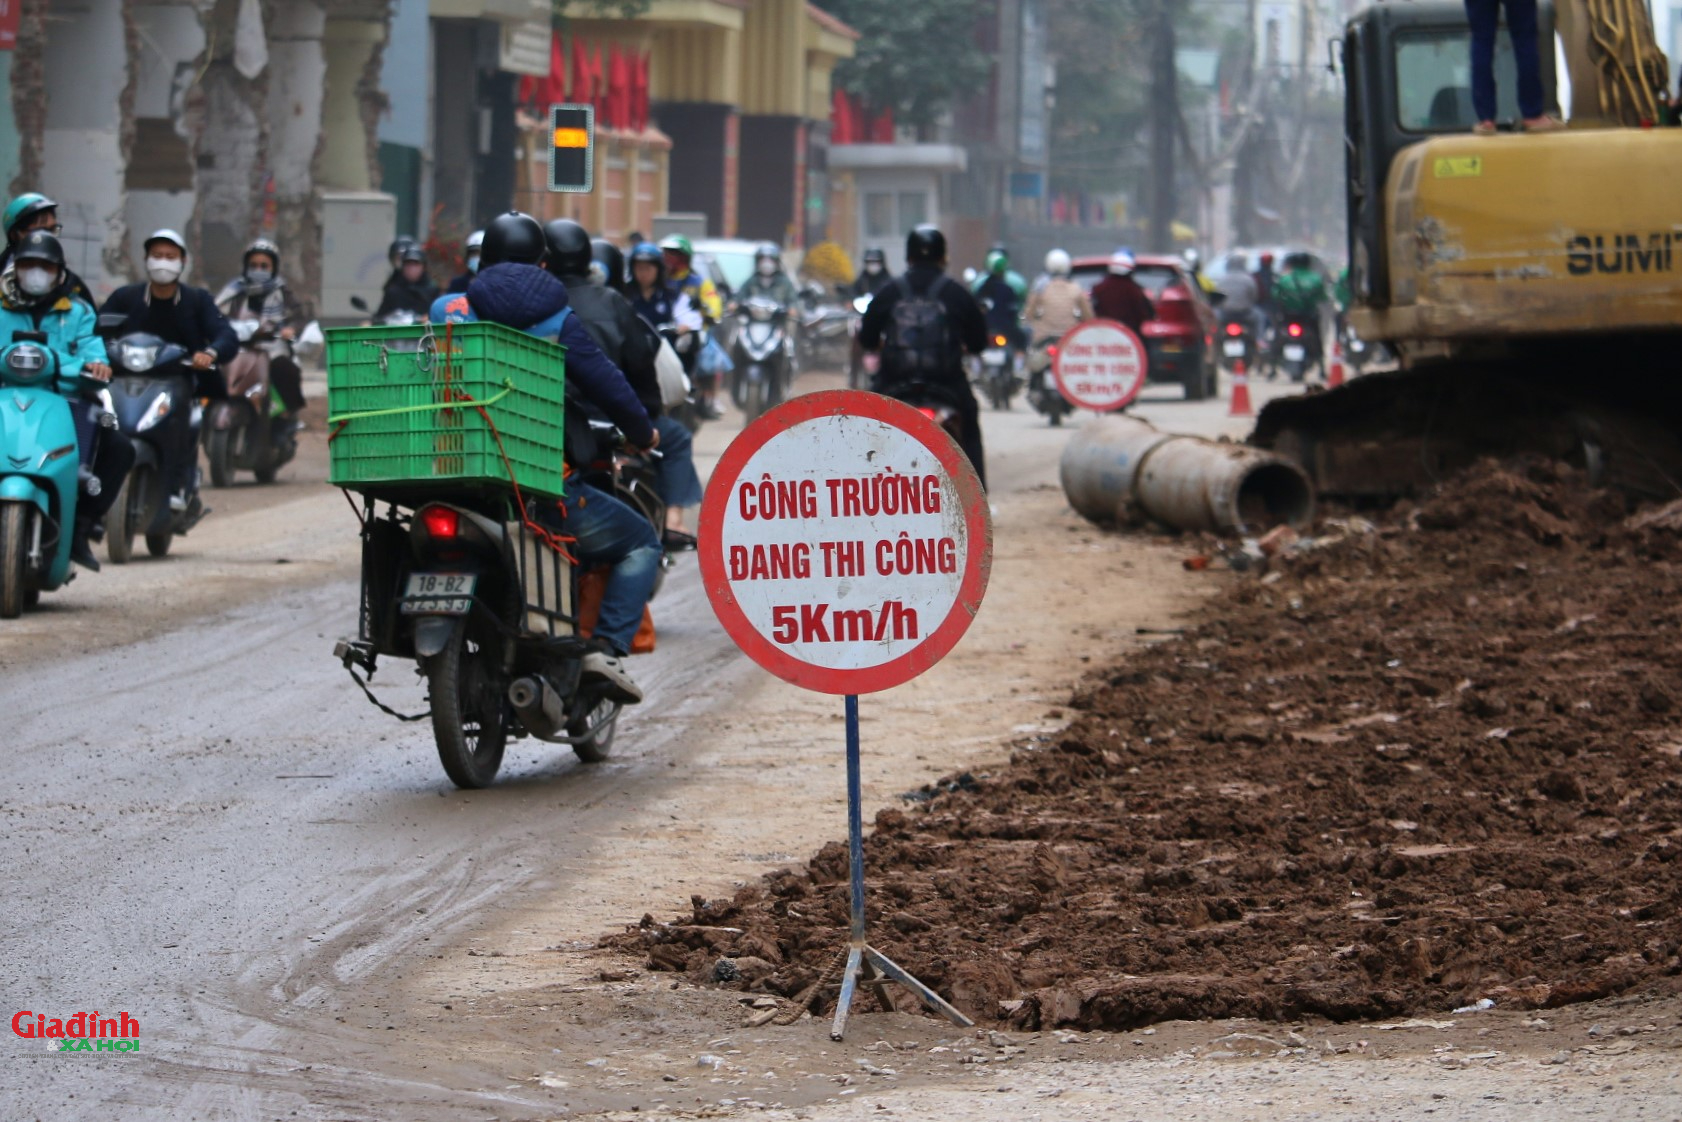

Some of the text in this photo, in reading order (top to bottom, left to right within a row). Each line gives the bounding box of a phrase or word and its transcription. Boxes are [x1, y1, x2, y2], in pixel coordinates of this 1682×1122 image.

[1566, 232, 1682, 276] SUMI
[739, 466, 941, 521] CÔNG TRƯỜNG
[729, 531, 956, 581] ĐANG THI CÔNG
[772, 600, 918, 644] 5Km/h
